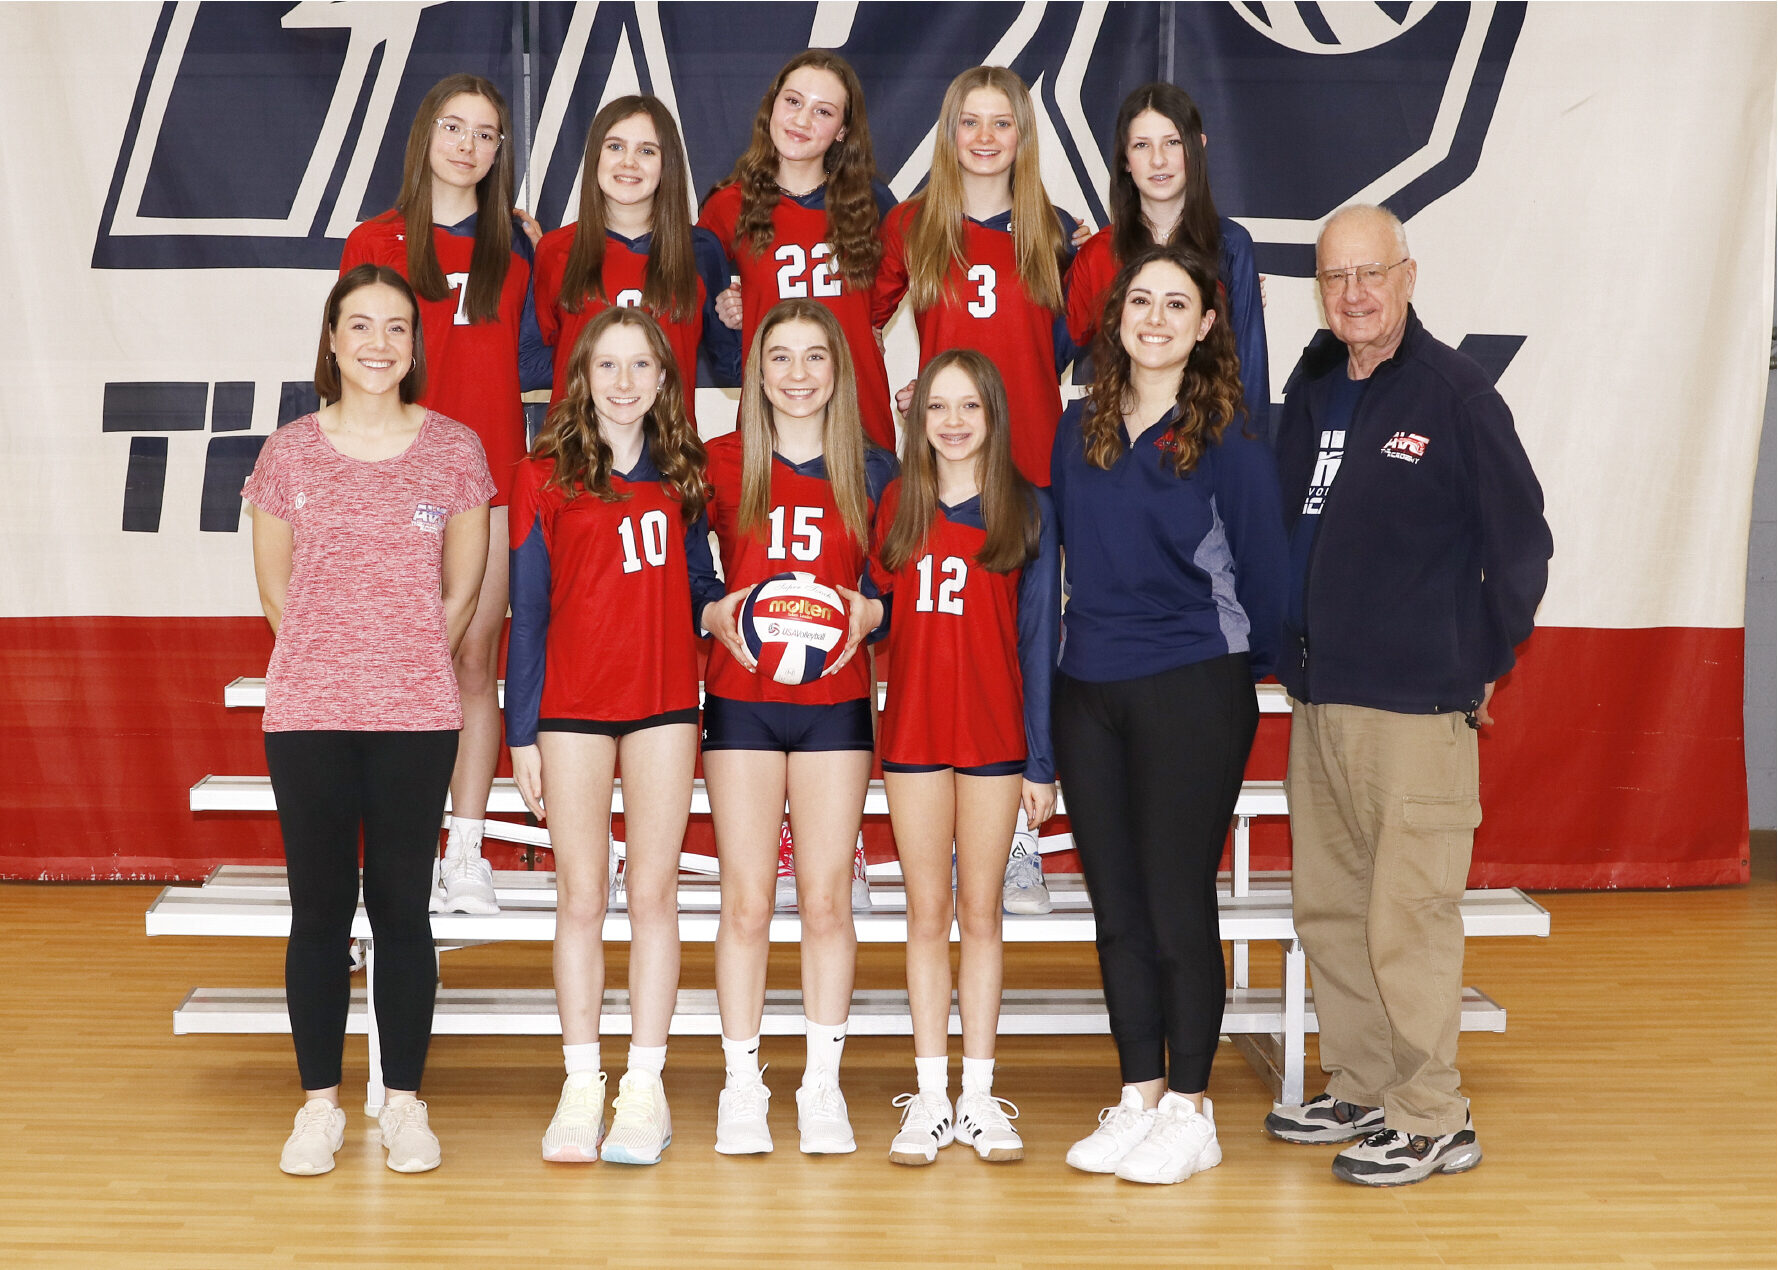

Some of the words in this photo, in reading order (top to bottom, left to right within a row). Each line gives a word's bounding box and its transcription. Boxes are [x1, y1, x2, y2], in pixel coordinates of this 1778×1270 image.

[445, 272, 471, 326] 7
[774, 242, 842, 300] 22
[967, 264, 998, 319] 3
[617, 509, 668, 574] 10
[767, 505, 824, 561] 15
[768, 599, 832, 621] molten
[915, 554, 968, 616] 12
